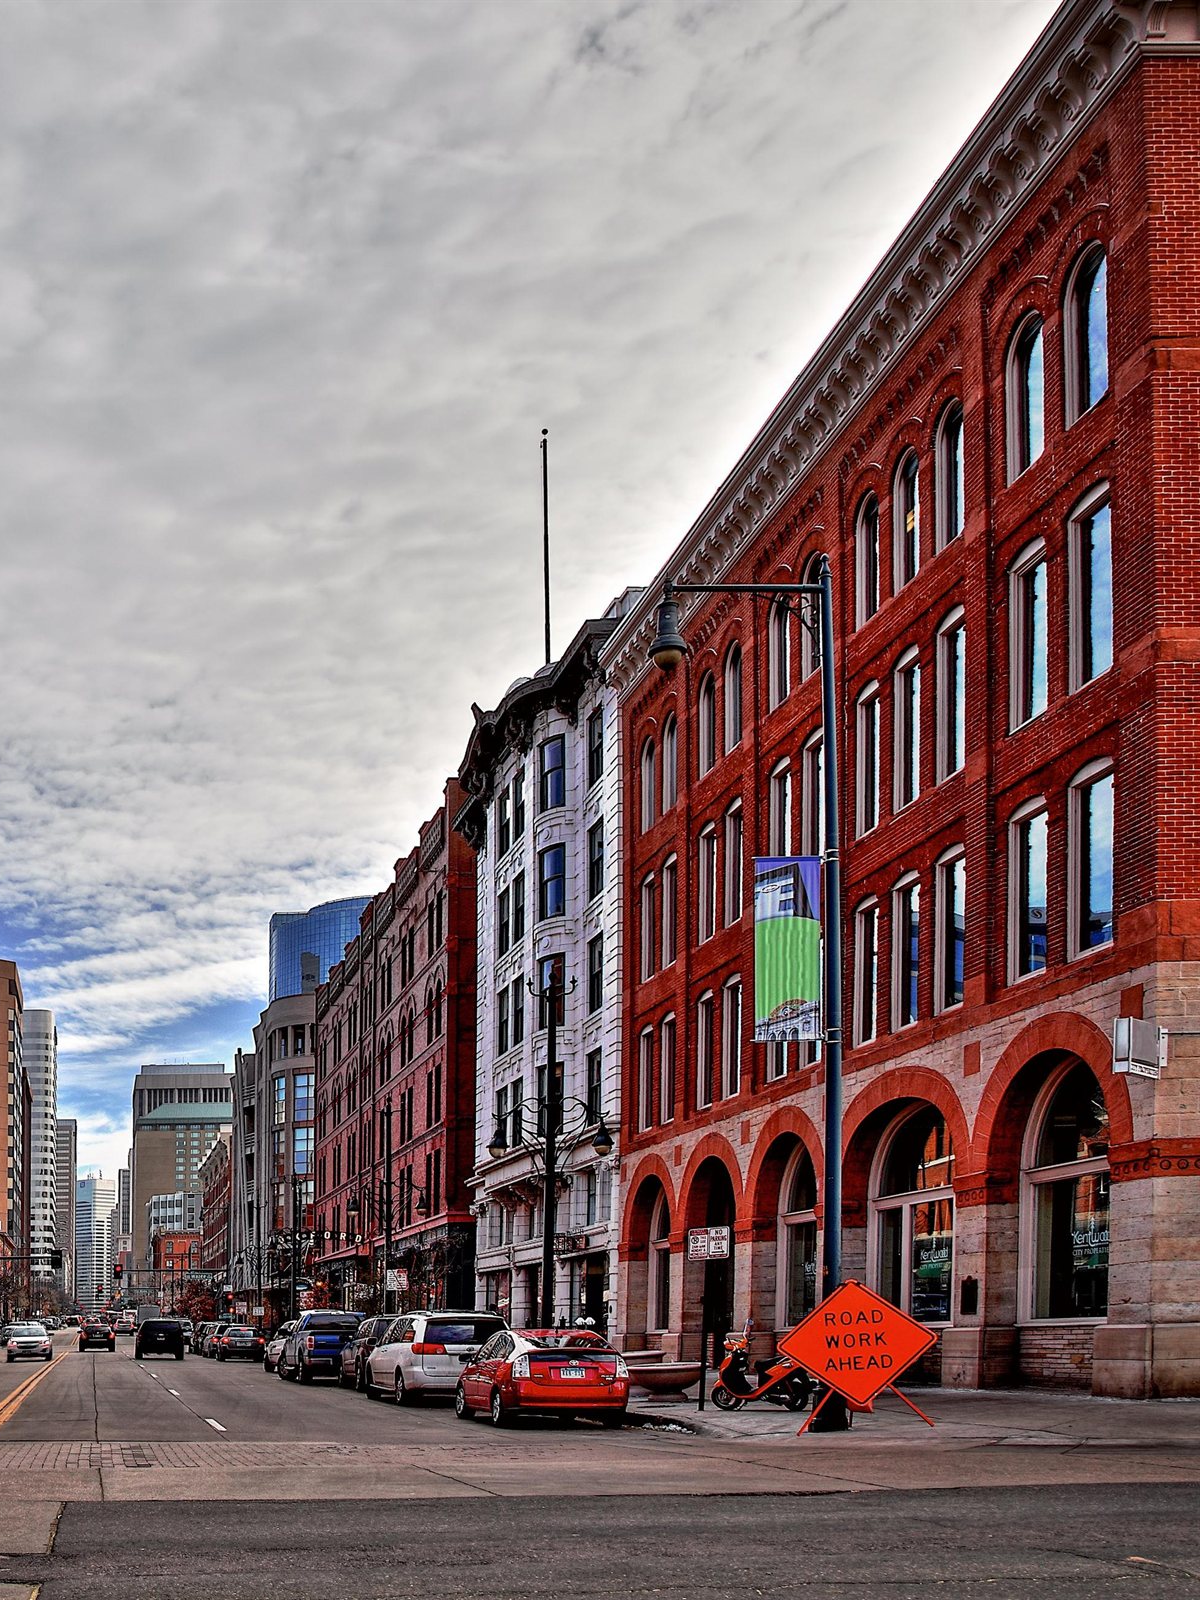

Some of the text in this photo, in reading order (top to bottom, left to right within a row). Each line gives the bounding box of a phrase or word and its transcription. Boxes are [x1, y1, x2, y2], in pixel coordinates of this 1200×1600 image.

[824, 1309, 884, 1327] ROAD
[825, 1331, 888, 1349] WORK
[825, 1354, 893, 1372] AHEAD
